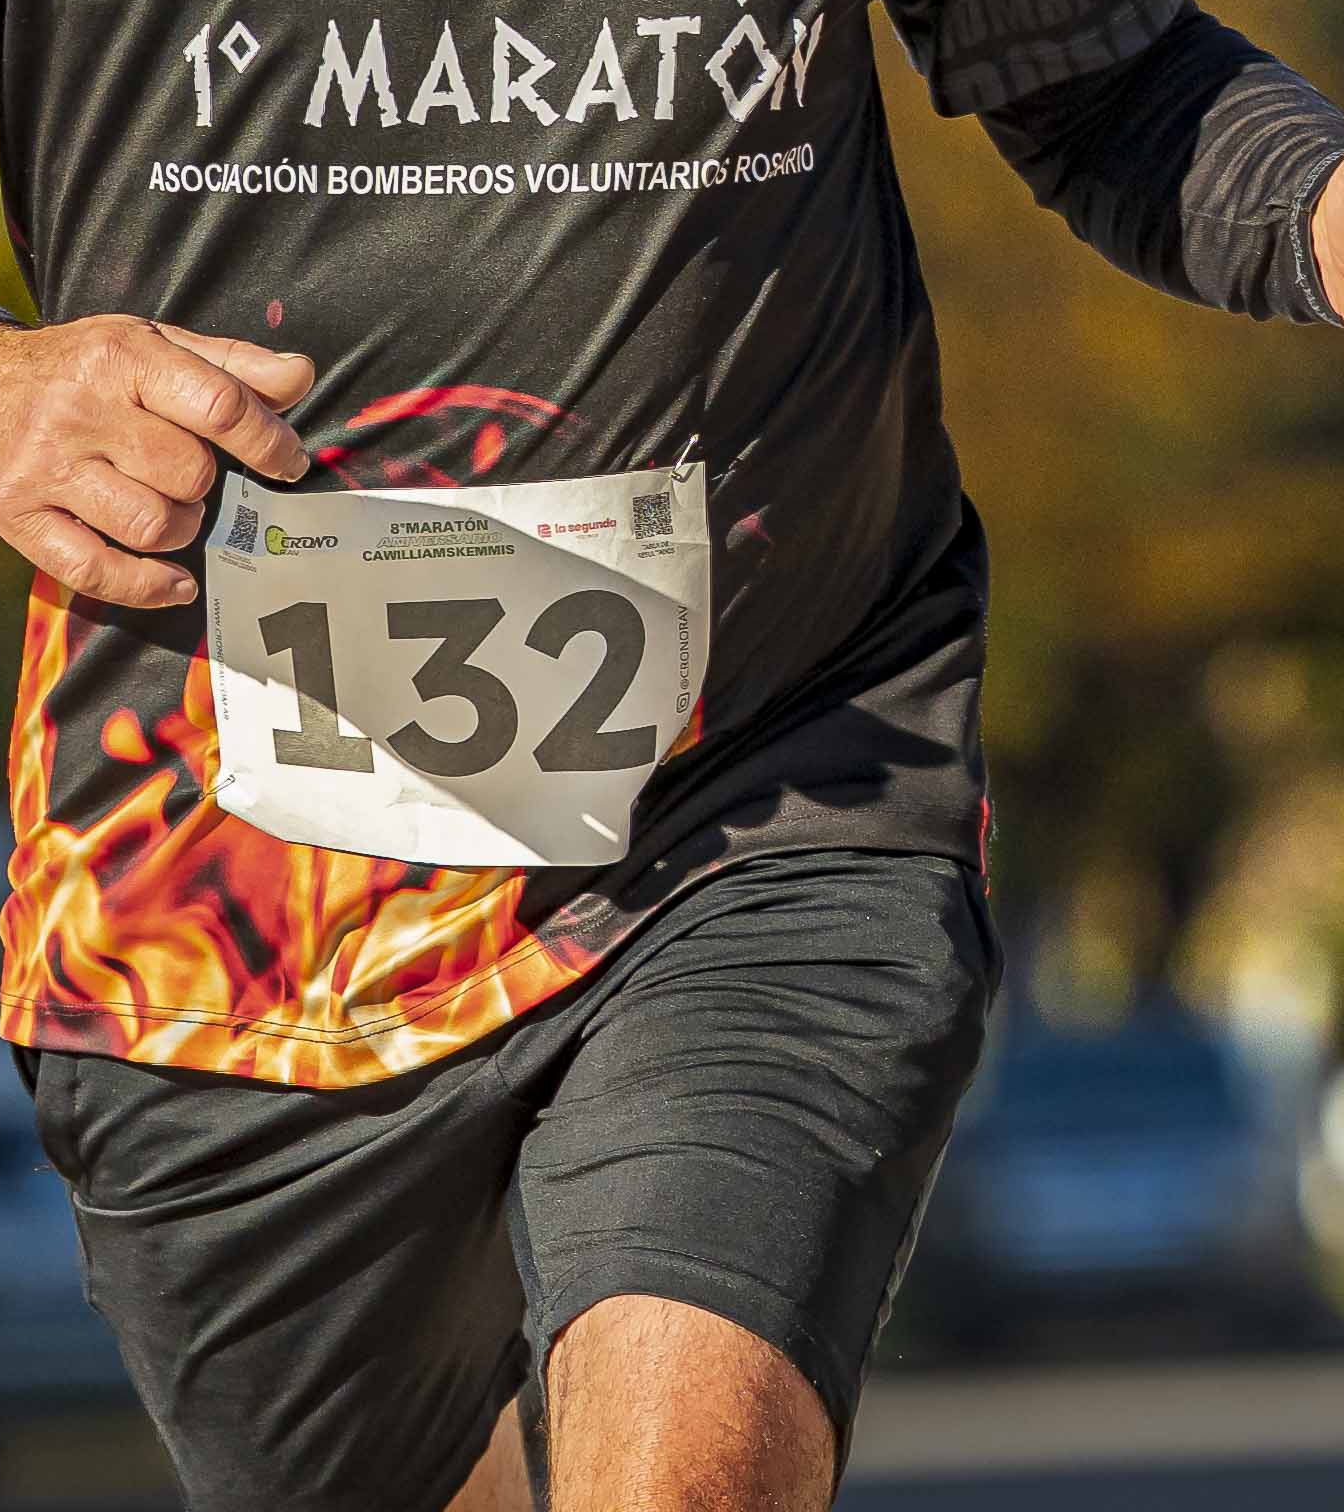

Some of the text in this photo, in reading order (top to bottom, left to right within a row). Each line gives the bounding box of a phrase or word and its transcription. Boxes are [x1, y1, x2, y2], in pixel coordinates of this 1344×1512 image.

[148, 141, 815, 195] ASOCIACIÓN BOMBEROS VOLUNTARIOS ROSARIO
[567, 517, 617, 534] segunda
[362, 544, 515, 562] CAWILLIAMSKEMMIS
[678, 605, 690, 690] @CRONORAV
[257, 589, 658, 778] 132
